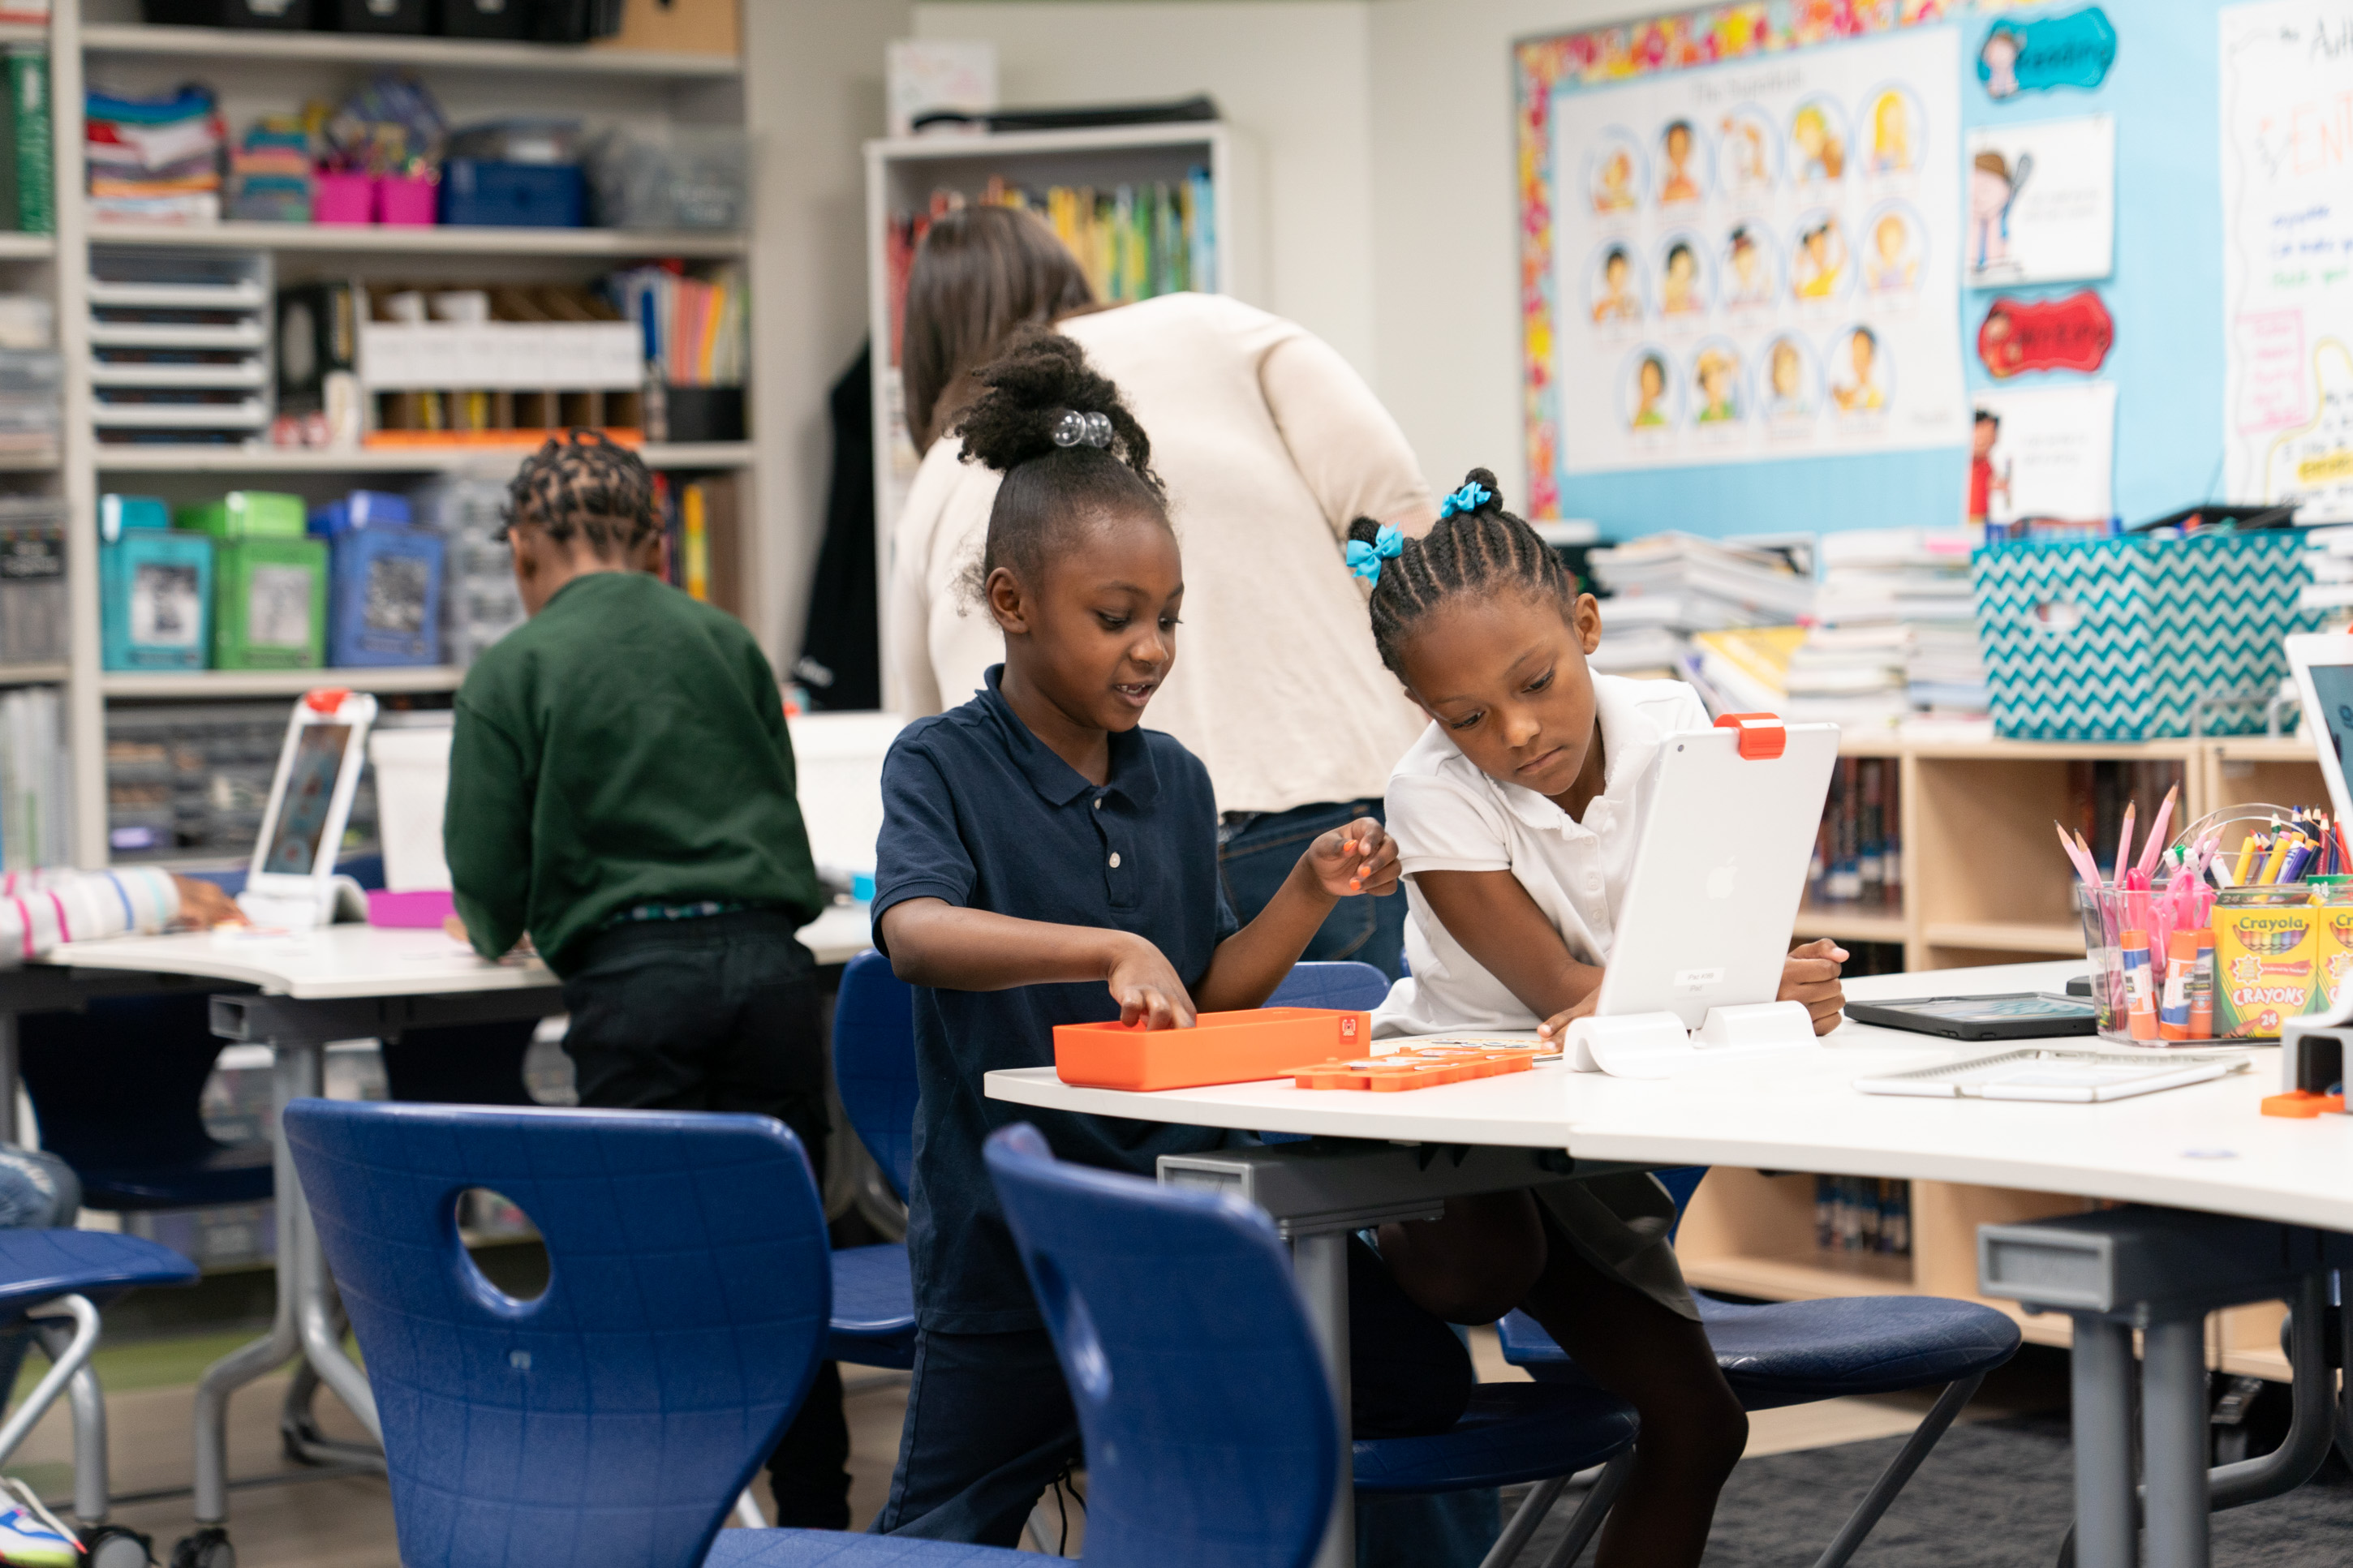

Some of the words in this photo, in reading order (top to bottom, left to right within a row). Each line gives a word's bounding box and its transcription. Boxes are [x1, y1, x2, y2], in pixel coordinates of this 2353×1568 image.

[2239, 916, 2304, 931] Crayola
[2233, 987, 2305, 1006] CRAYONS
[2261, 1012, 2278, 1026] 24
